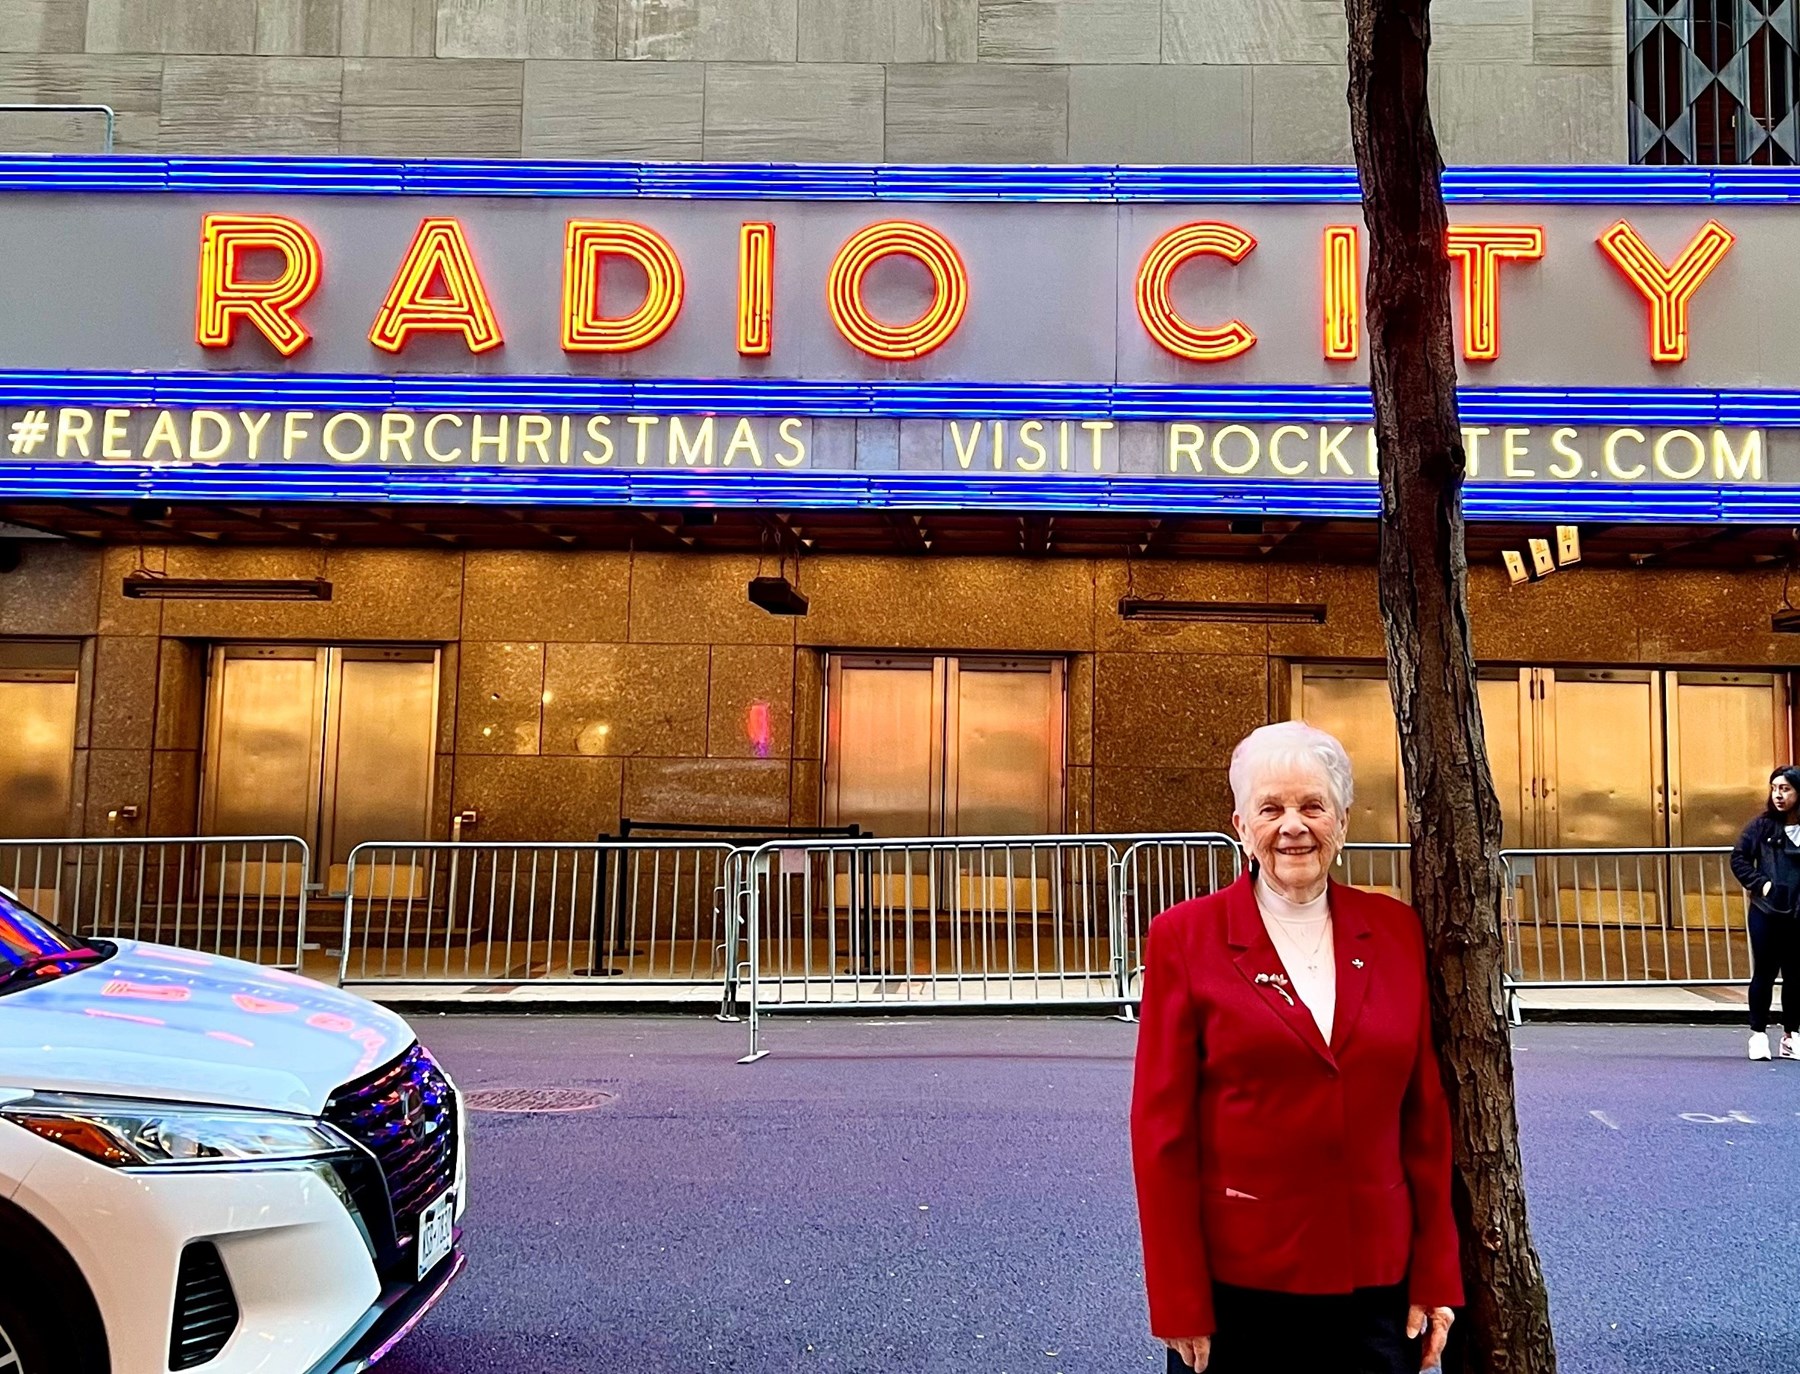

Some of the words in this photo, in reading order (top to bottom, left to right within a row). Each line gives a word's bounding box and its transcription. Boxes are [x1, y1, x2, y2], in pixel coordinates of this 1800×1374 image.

[195, 213, 969, 361] RADIO
[1136, 217, 1736, 364] CITY
[8, 408, 805, 468] #READYFORCHRISTMAS
[950, 420, 1113, 472] VISIT
[1168, 424, 1763, 479] ROCKTES.COM
